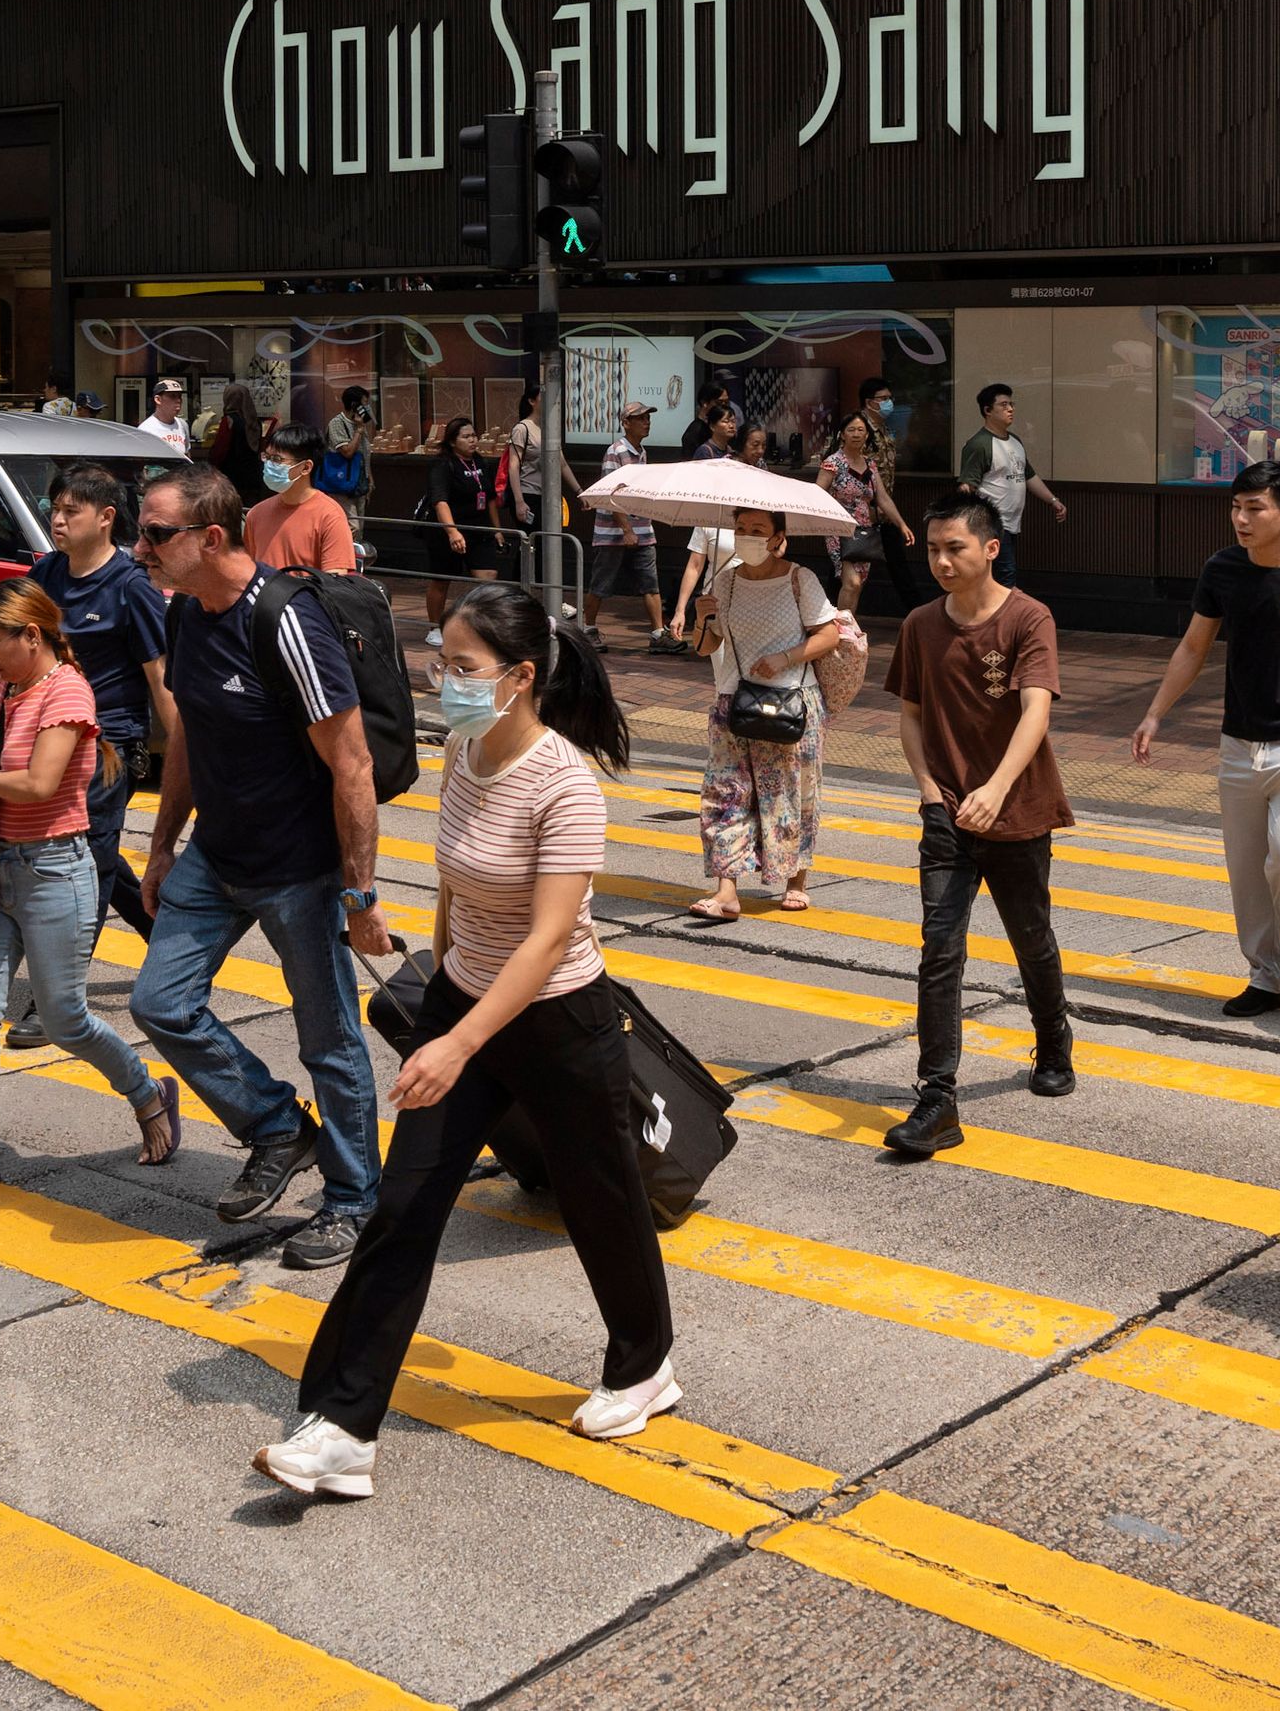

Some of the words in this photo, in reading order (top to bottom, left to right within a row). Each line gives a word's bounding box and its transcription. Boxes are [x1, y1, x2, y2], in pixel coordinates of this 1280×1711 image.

[1229, 329, 1269, 341] SANRIO
[638, 386, 662, 396] YUYU
[223, 683, 245, 693] adidas
